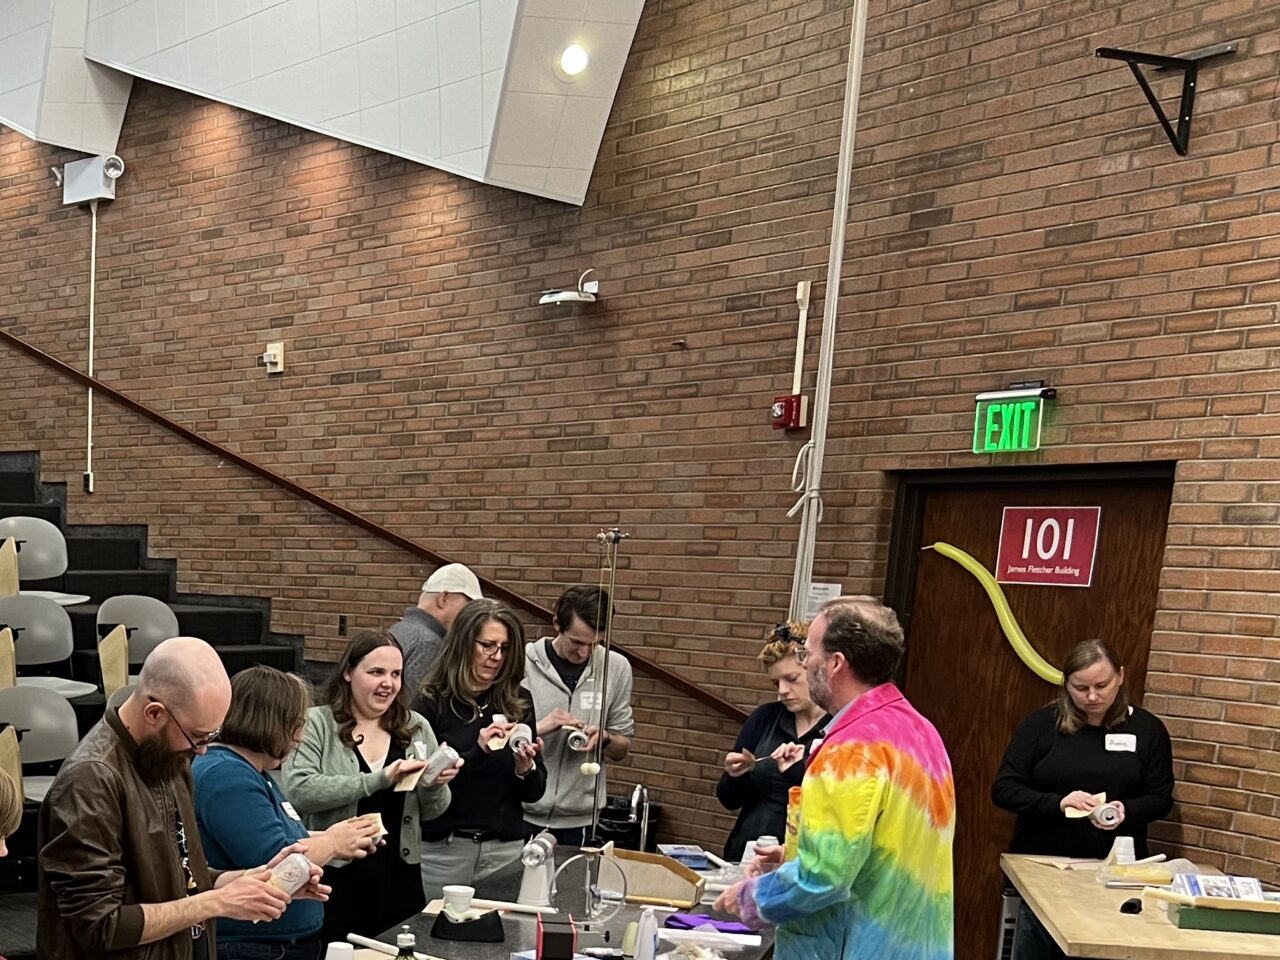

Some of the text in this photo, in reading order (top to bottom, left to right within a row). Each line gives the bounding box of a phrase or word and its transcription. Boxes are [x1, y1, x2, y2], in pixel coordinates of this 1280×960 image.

[985, 402, 1036, 450] EXIT
[1022, 518, 1074, 560] 101
[1007, 564, 1080, 577] James Fletcher Building
